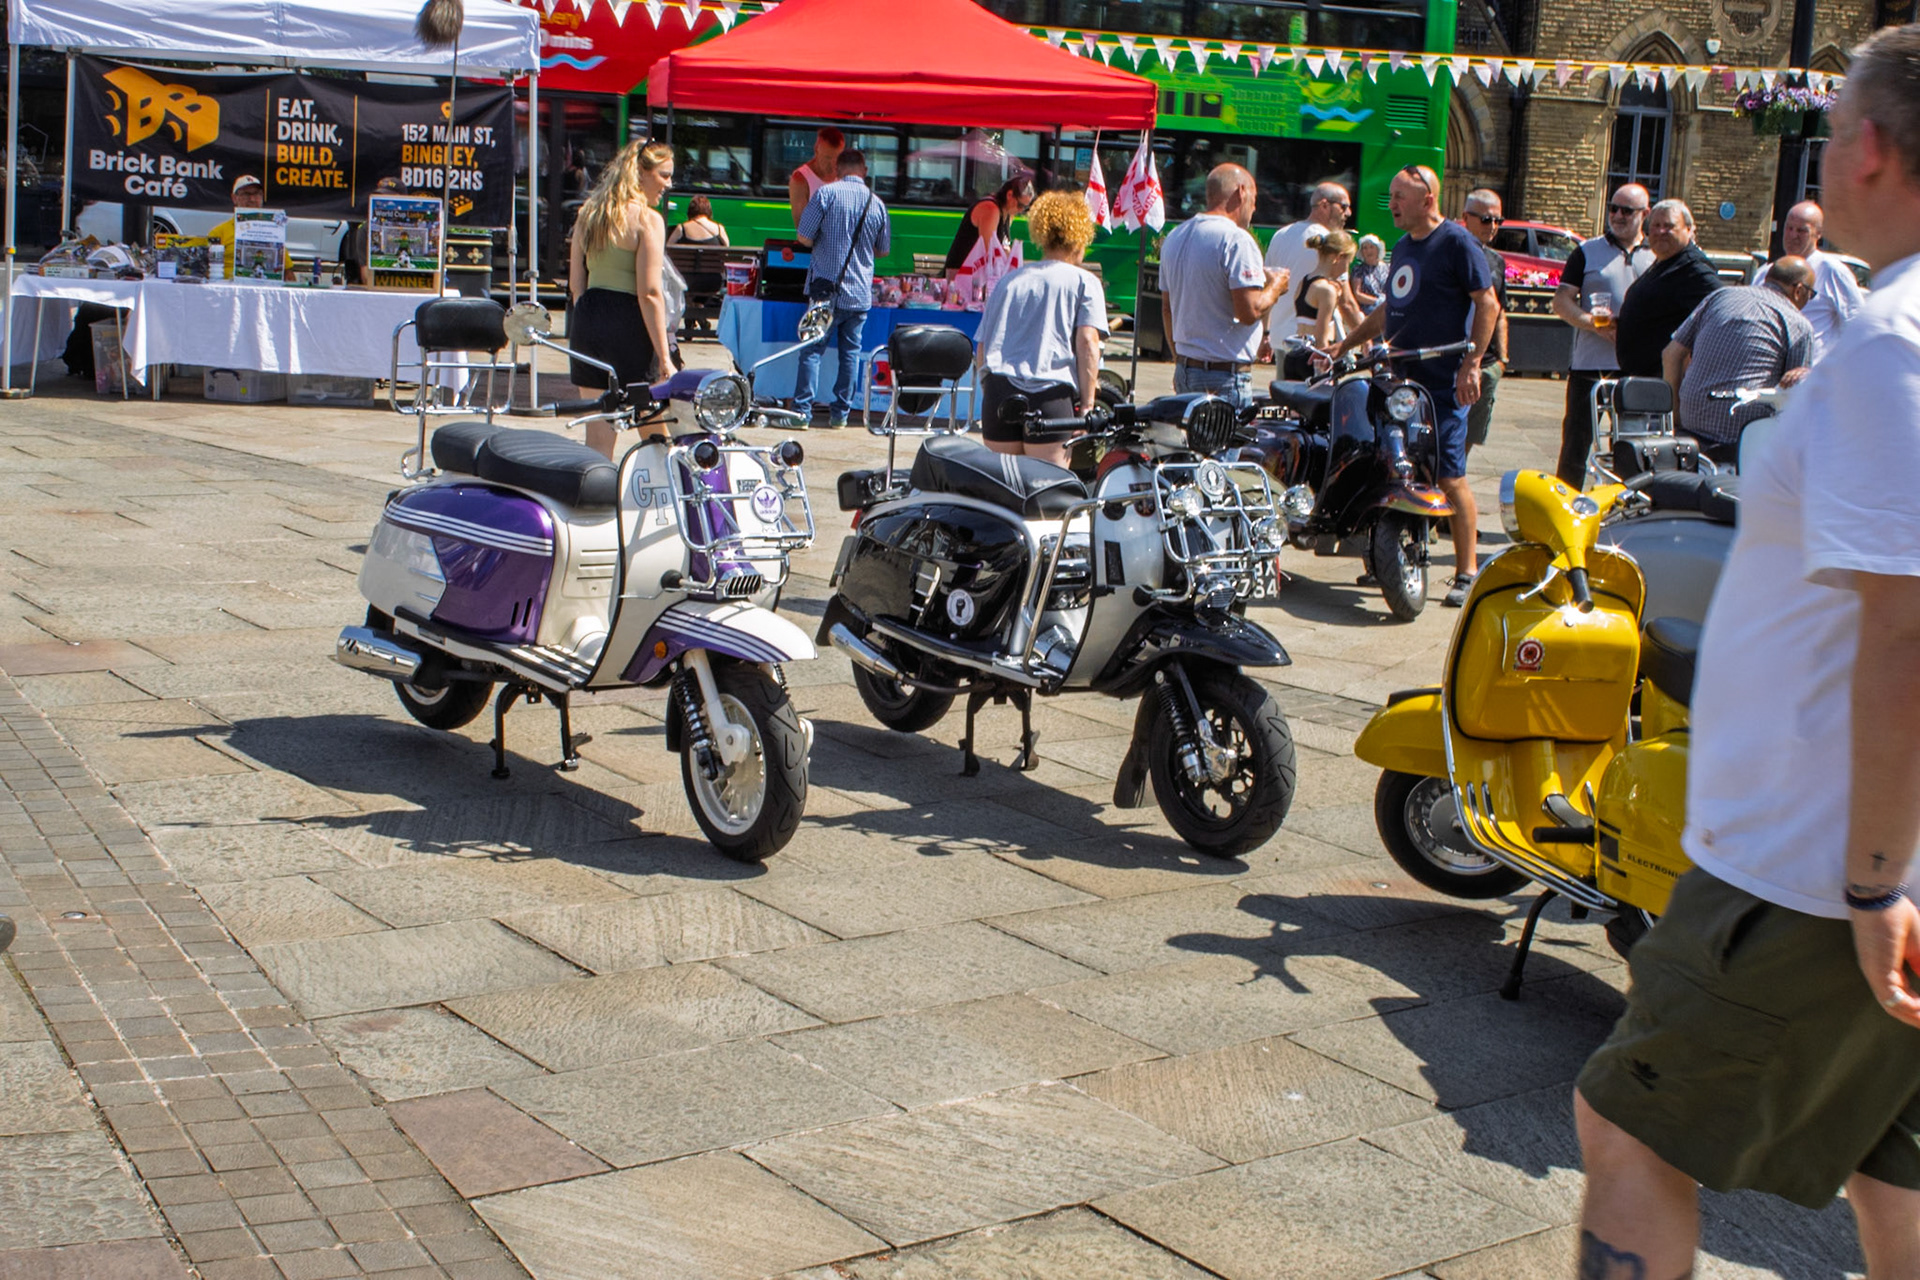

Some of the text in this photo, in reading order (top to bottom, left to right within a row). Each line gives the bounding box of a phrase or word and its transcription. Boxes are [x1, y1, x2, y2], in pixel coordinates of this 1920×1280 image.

[278, 97, 317, 122] EAT,
[277, 120, 343, 147] DRINK,
[401, 124, 496, 148] 152 MAIN ST,
[89, 149, 224, 180] Brick Bank
[276, 144, 337, 169] BUILD,
[401, 144, 479, 170] BINGLEY,
[124, 174, 188, 199] Café
[275, 166, 348, 188] CREATE.
[401, 166, 484, 191] BD16 2HS
